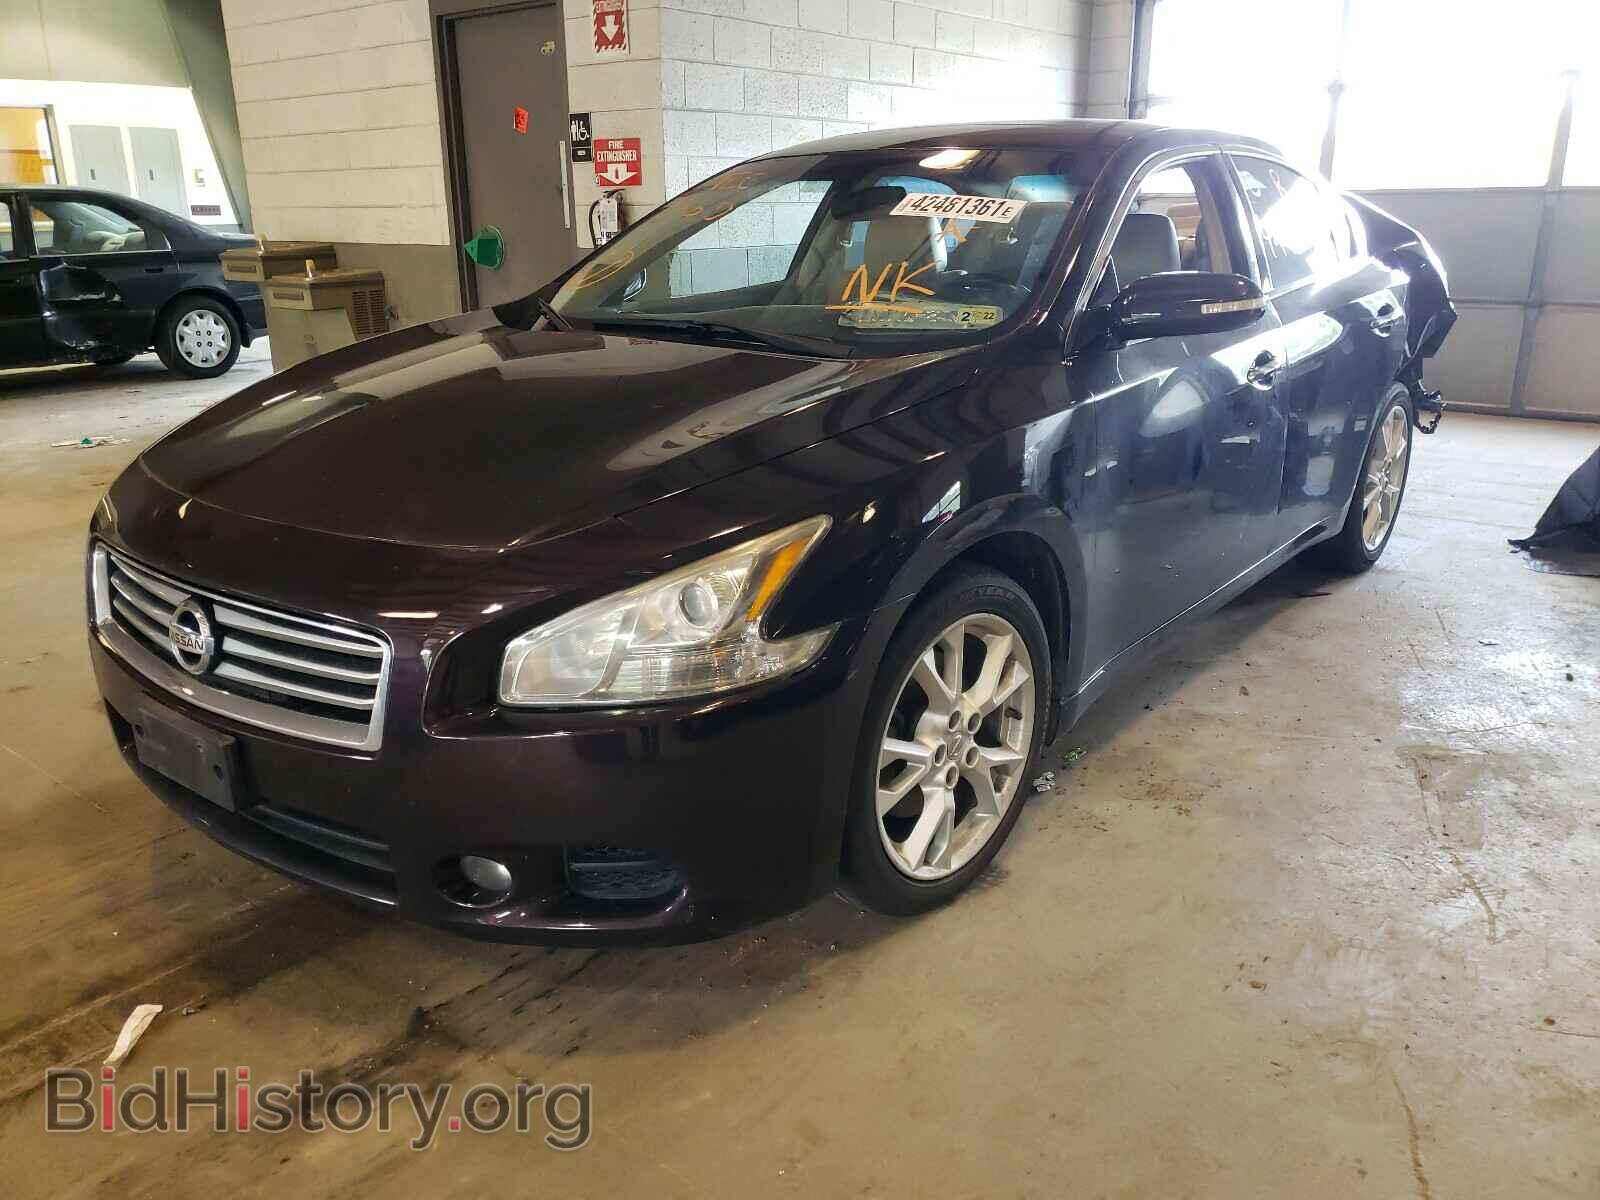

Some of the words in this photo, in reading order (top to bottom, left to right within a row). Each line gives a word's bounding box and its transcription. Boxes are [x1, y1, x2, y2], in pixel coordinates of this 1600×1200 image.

[608, 140, 625, 149] FIRE
[596, 149, 638, 162] EXTINGUISHER
[841, 262, 937, 303] NK
[960, 311, 971, 322] 2
[983, 311, 994, 320] 22
